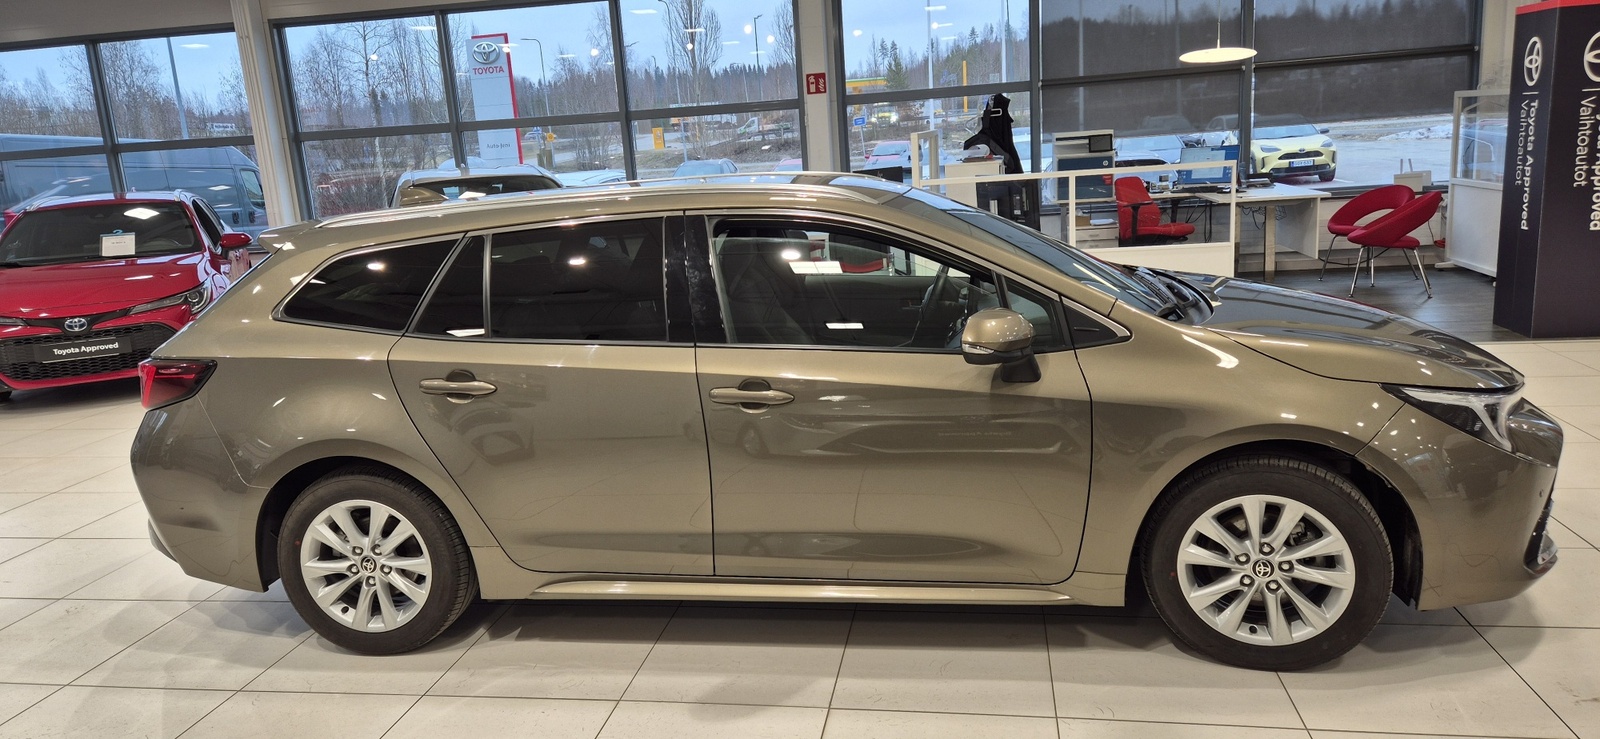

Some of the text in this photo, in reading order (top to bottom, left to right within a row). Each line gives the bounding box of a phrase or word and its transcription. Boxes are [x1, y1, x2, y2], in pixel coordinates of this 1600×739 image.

[473, 65, 504, 75] TOYOTA
[1514, 99, 1529, 186] Vaihtoautot
[1521, 99, 1538, 231] Toyota Approved
[1573, 96, 1597, 188] Vaihtoautot
[53, 342, 119, 356] Toyota Approved
